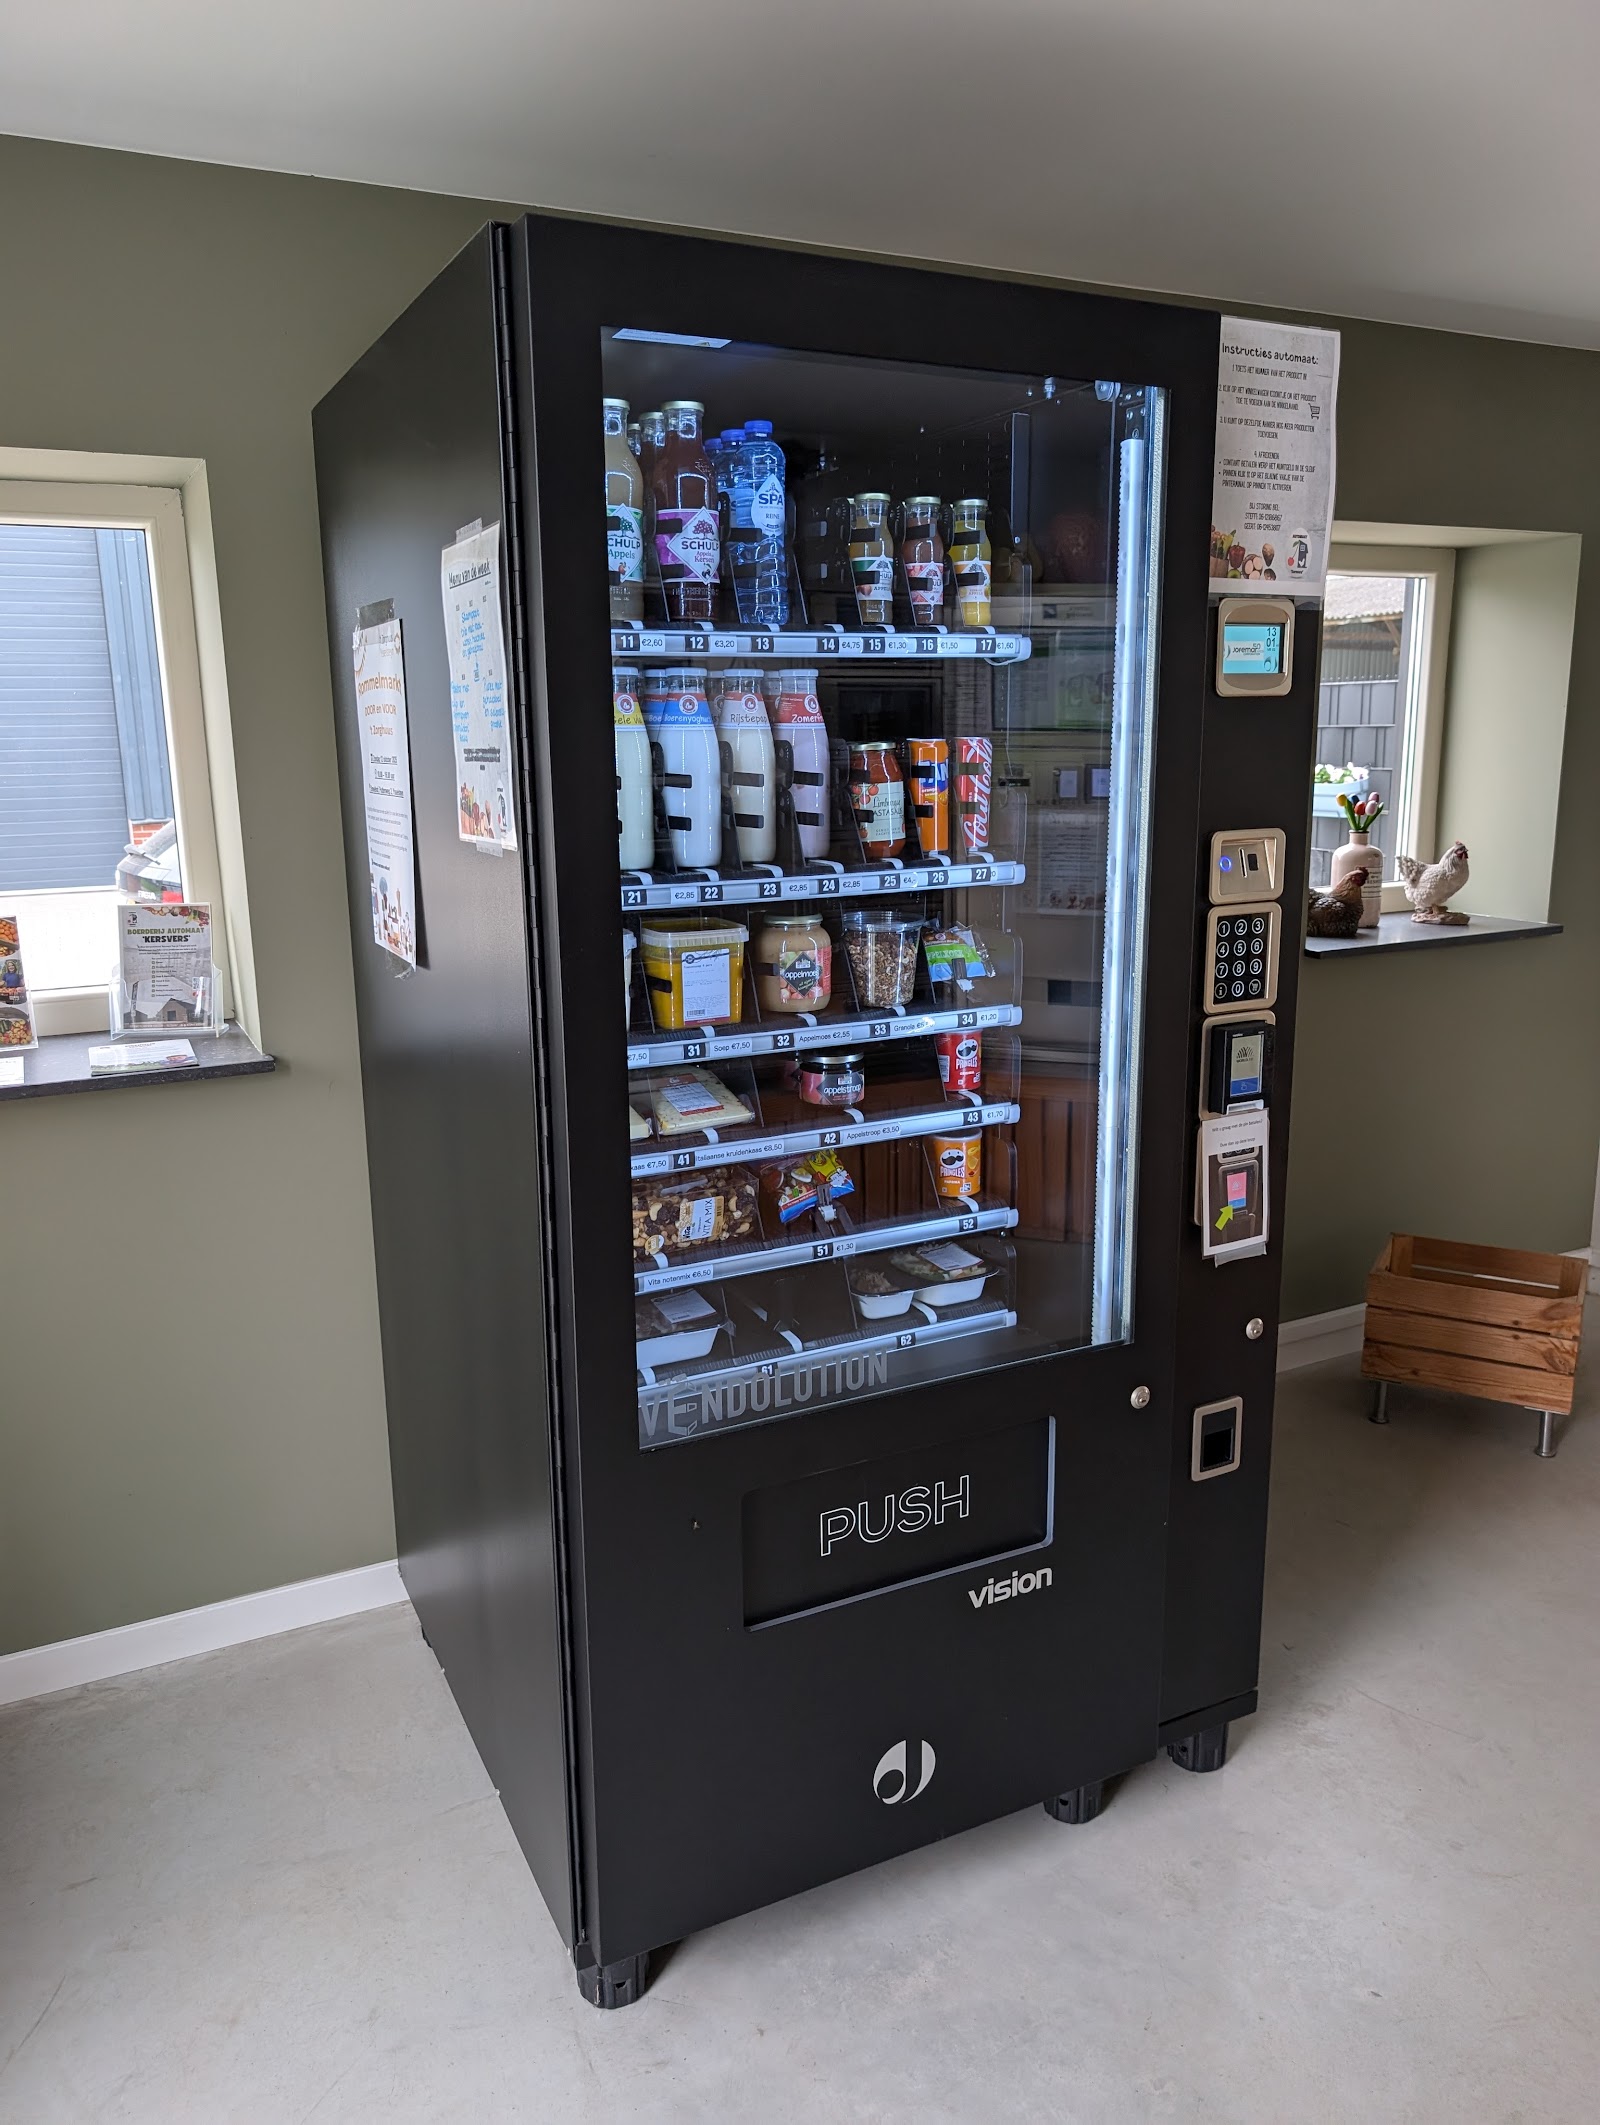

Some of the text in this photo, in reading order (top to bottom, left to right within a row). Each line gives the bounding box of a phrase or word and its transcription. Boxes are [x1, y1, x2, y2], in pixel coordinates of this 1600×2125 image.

[1222, 342, 1319, 365] Instructies automaat:
[1286, 370, 1302, 379] PRODUCT
[1301, 392, 1317, 402] PRODUCT
[758, 493, 783, 506] SPA
[607, 539, 641, 549] CHULP
[681, 540, 719, 551] SCHULP
[608, 549, 636, 560] Appels
[461, 569, 470, 581] van
[477, 558, 490, 575] week
[1267, 628, 1277, 637] 13
[621, 636, 663, 648] 11 €2,60
[690, 636, 735, 649] 12 €3,20
[756, 638, 770, 650] 13
[822, 639, 861, 650] 14 €4,75
[868, 639, 907, 650] 15 €1,30
[922, 639, 958, 650] 16 €1,50
[981, 639, 1014, 651] 17 €1,60
[1266, 638, 1275, 647] 01
[365, 704, 376, 716] DOOR
[382, 704, 396, 715] VOOR
[731, 714, 767, 725] Rijstepap
[933, 872, 944, 883] 26
[976, 868, 987, 879] 27
[822, 880, 835, 892] 24
[884, 876, 896, 886] 25
[705, 887, 718, 899] 22
[764, 884, 808, 896] 23 €2,85
[628, 891, 641, 903] 21
[1221, 921, 1261, 934] 1 2 3
[1220, 941, 1259, 955] 4 5 6
[1219, 962, 1259, 976] 7 8 9
[1235, 984, 1241, 994] 0
[962, 1013, 997, 1024] 34 €1,20
[874, 1023, 915, 1035] 33 Granola
[777, 1030, 851, 1047] 32 Appelmoes €2,55
[688, 1042, 751, 1057] 31 Soep €7,50
[956, 1056, 977, 1070] PRINGLES
[824, 1084, 861, 1096] appelstroop
[968, 1110, 1003, 1122] 43 €1,70
[824, 1126, 900, 1144] 42 Appelstroop €3,50
[677, 1143, 782, 1166] 41 Italiaanse kruidenkaas €8,50
[647, 1159, 667, 1169] €7,50
[940, 1165, 965, 1178] PRINGLES
[702, 1217, 712, 1237] VITA
[963, 1219, 974, 1229] 52
[817, 1243, 853, 1257] 51 €1,30
[648, 1268, 711, 1286] Vita notenmix €6,50
[901, 1335, 912, 1346] 62
[640, 1347, 889, 1437] VENDOLUTION
[819, 1475, 970, 1556] PUSH
[968, 1567, 1053, 1608] vision
